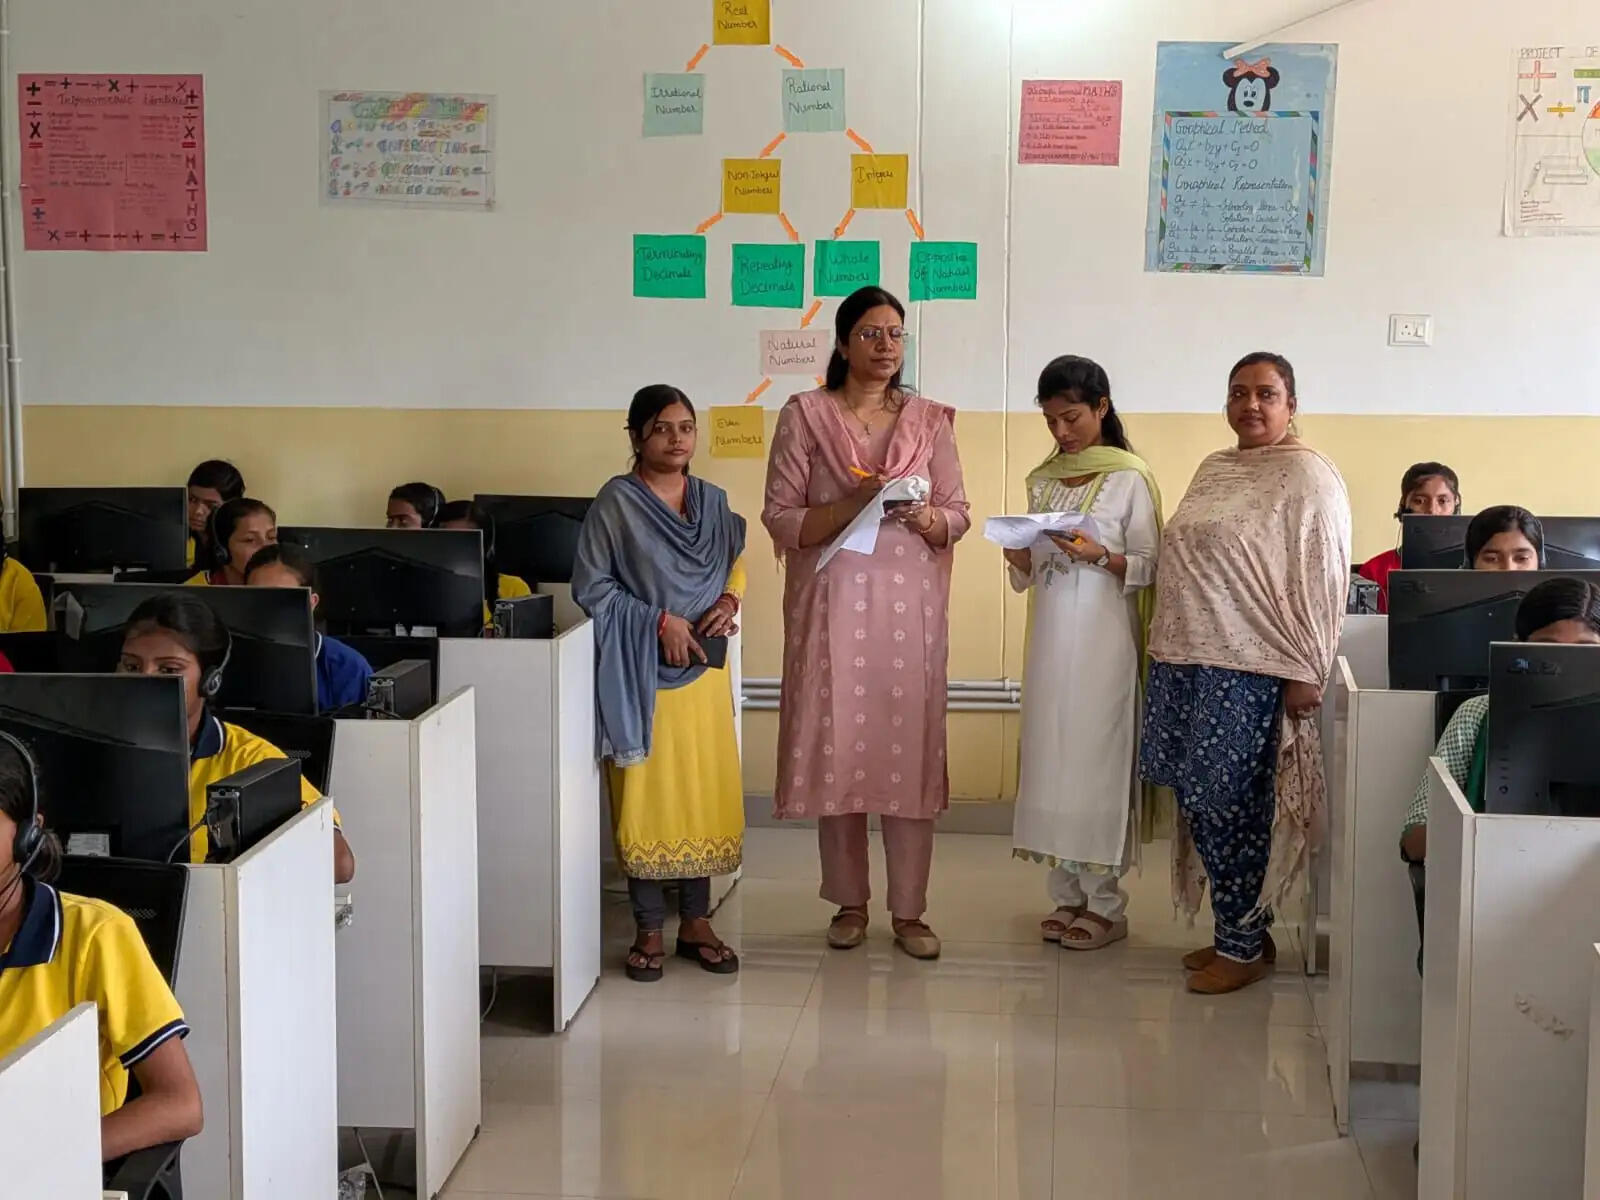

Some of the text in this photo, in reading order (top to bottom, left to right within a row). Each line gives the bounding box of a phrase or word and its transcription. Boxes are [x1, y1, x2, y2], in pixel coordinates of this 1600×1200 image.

[720, 1, 749, 16] Real
[786, 77, 831, 94] Rational
[788, 101, 833, 114] Number
[768, 333, 816, 352] Natural
[768, 354, 816, 367] Numbers
[715, 432, 763, 448] Numbers
